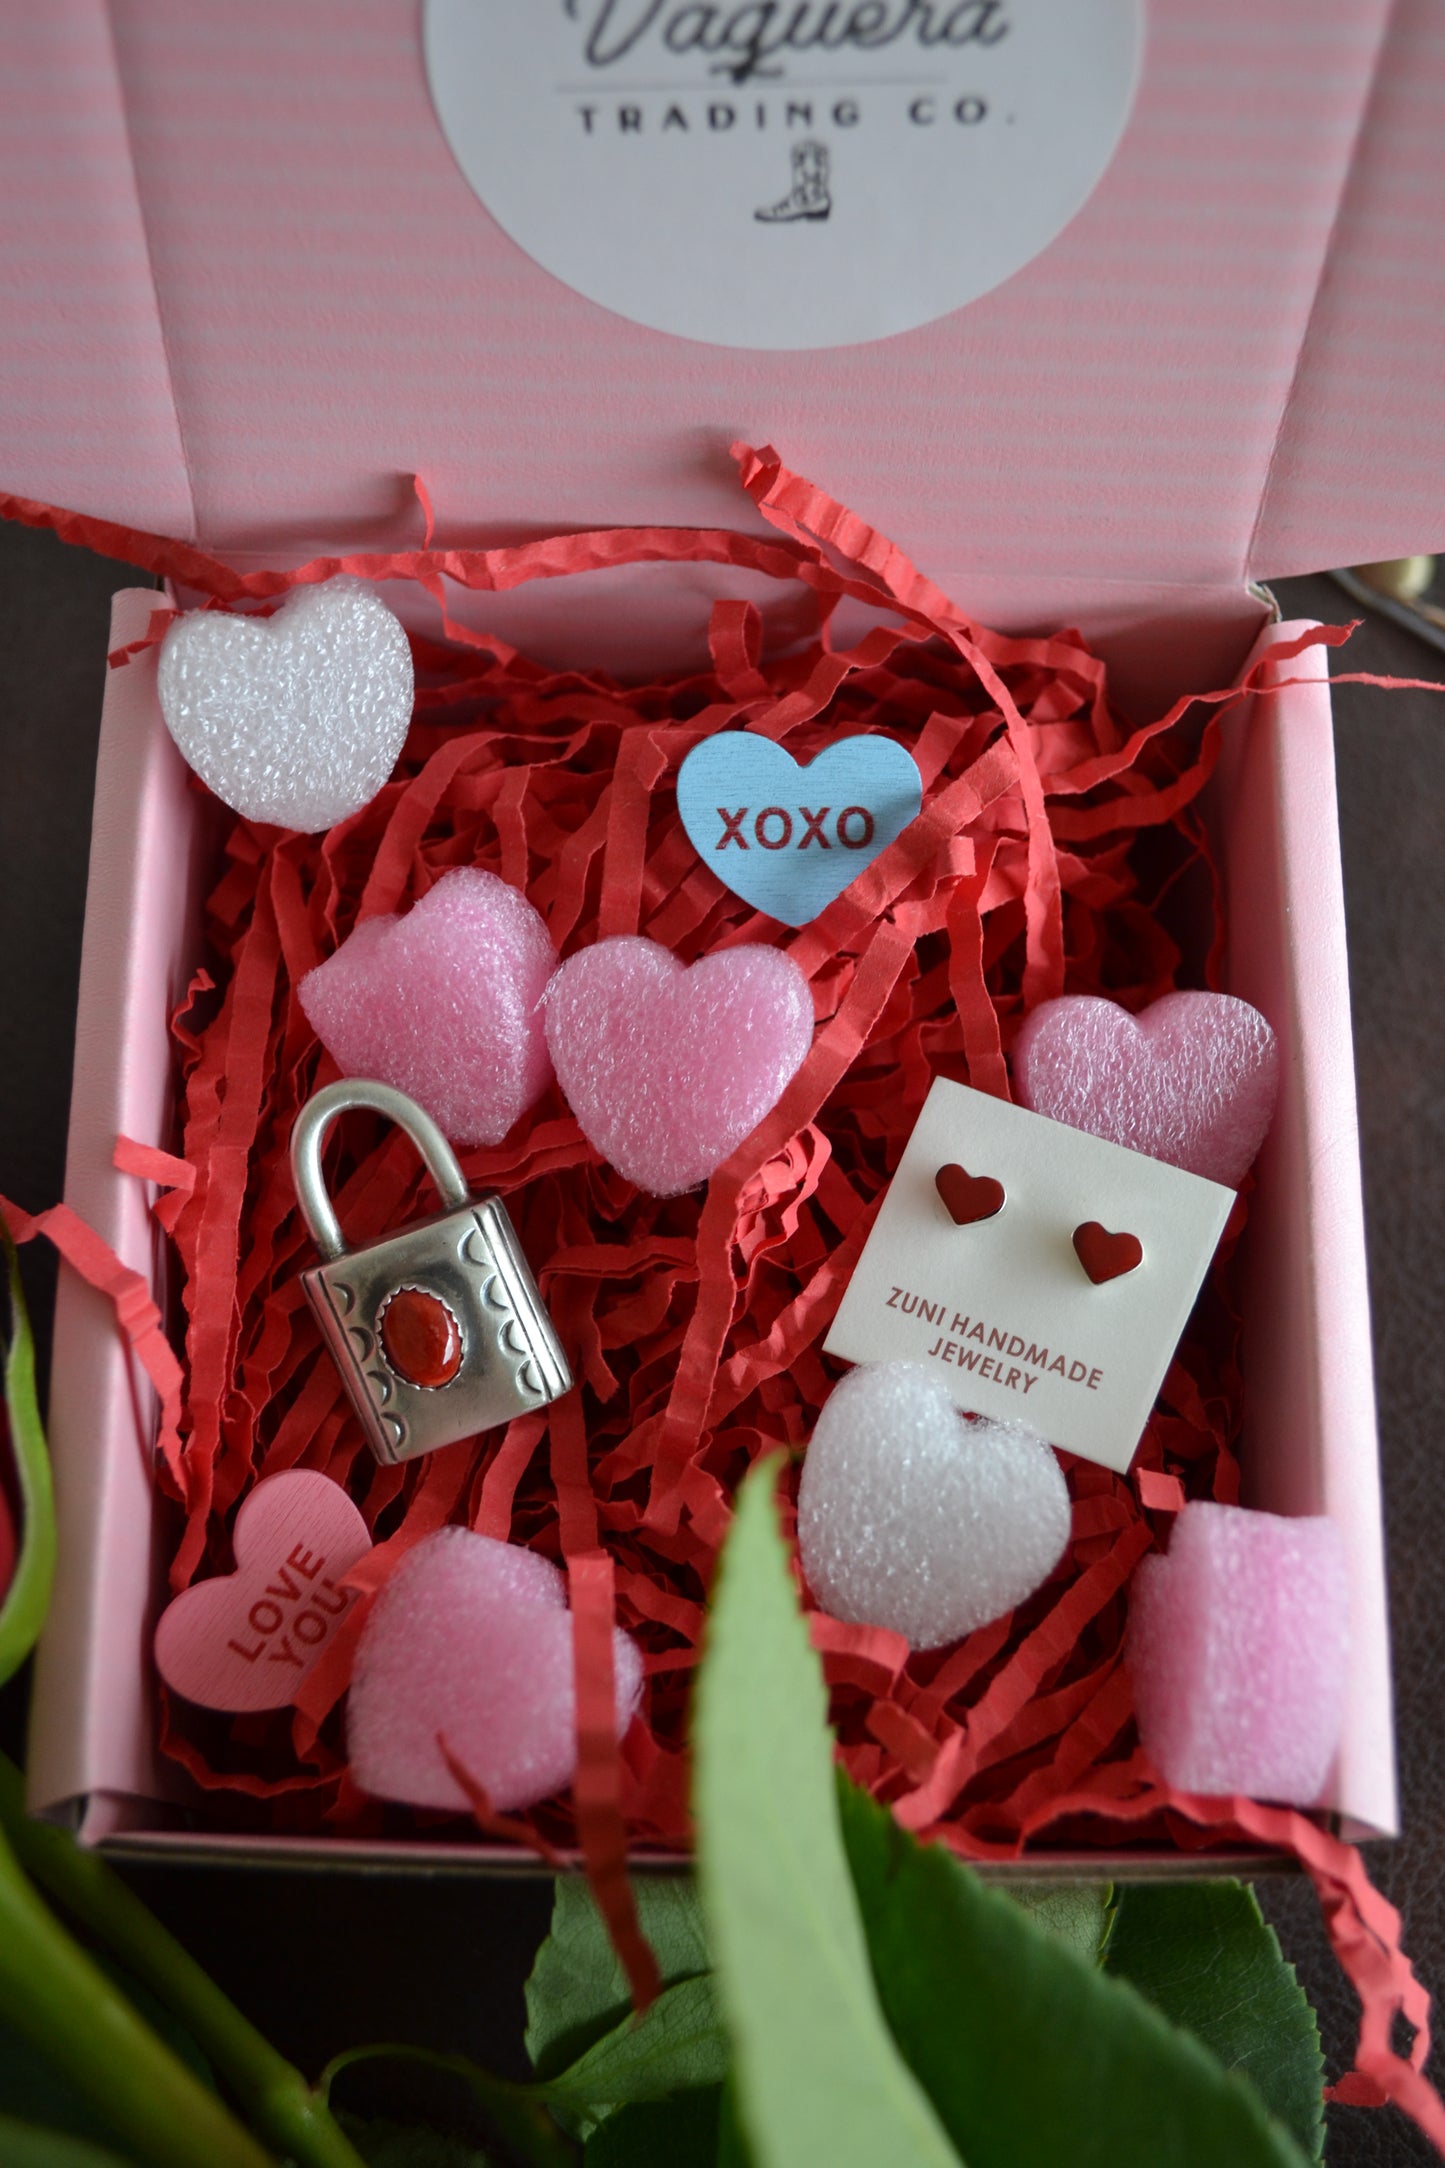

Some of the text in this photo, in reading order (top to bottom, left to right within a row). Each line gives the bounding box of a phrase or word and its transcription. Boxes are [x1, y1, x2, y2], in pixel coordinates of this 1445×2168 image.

[576, 97, 1018, 135] TRADING CO.
[715, 805, 876, 851] XOXO
[885, 1286, 1105, 1391] ZUNI HANDMADE
[928, 1337, 1040, 1395] JEWELRY
[227, 1543, 326, 1664] LOVE
[267, 1578, 351, 1669] YOU
